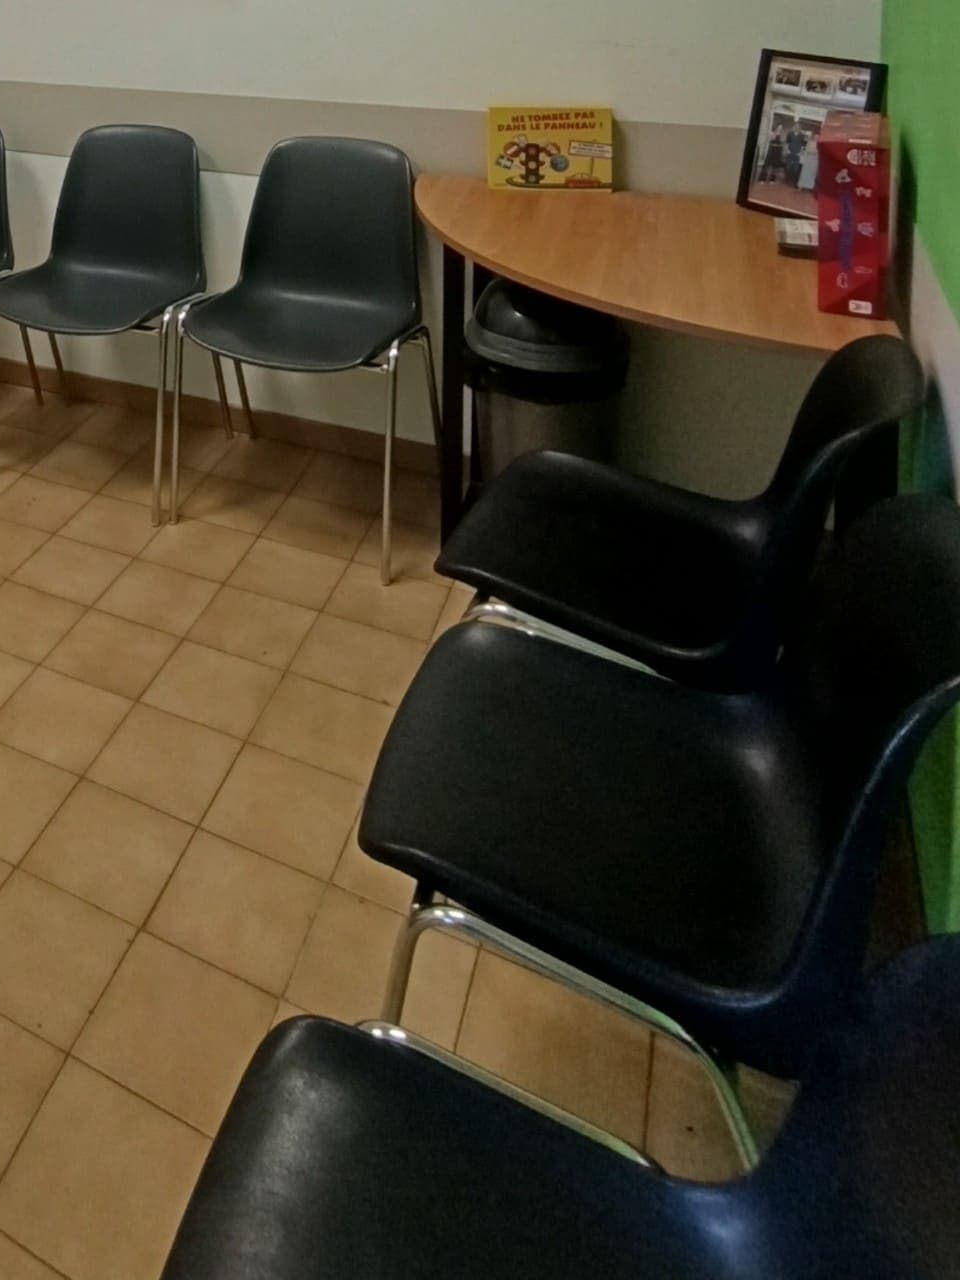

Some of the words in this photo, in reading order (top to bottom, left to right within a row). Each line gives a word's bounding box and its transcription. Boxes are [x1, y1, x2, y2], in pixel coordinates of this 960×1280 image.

[574, 110, 595, 119] PAS
[497, 123, 527, 132] DANS
[530, 122, 540, 131] LE
[544, 121, 596, 131] PANNEAU
